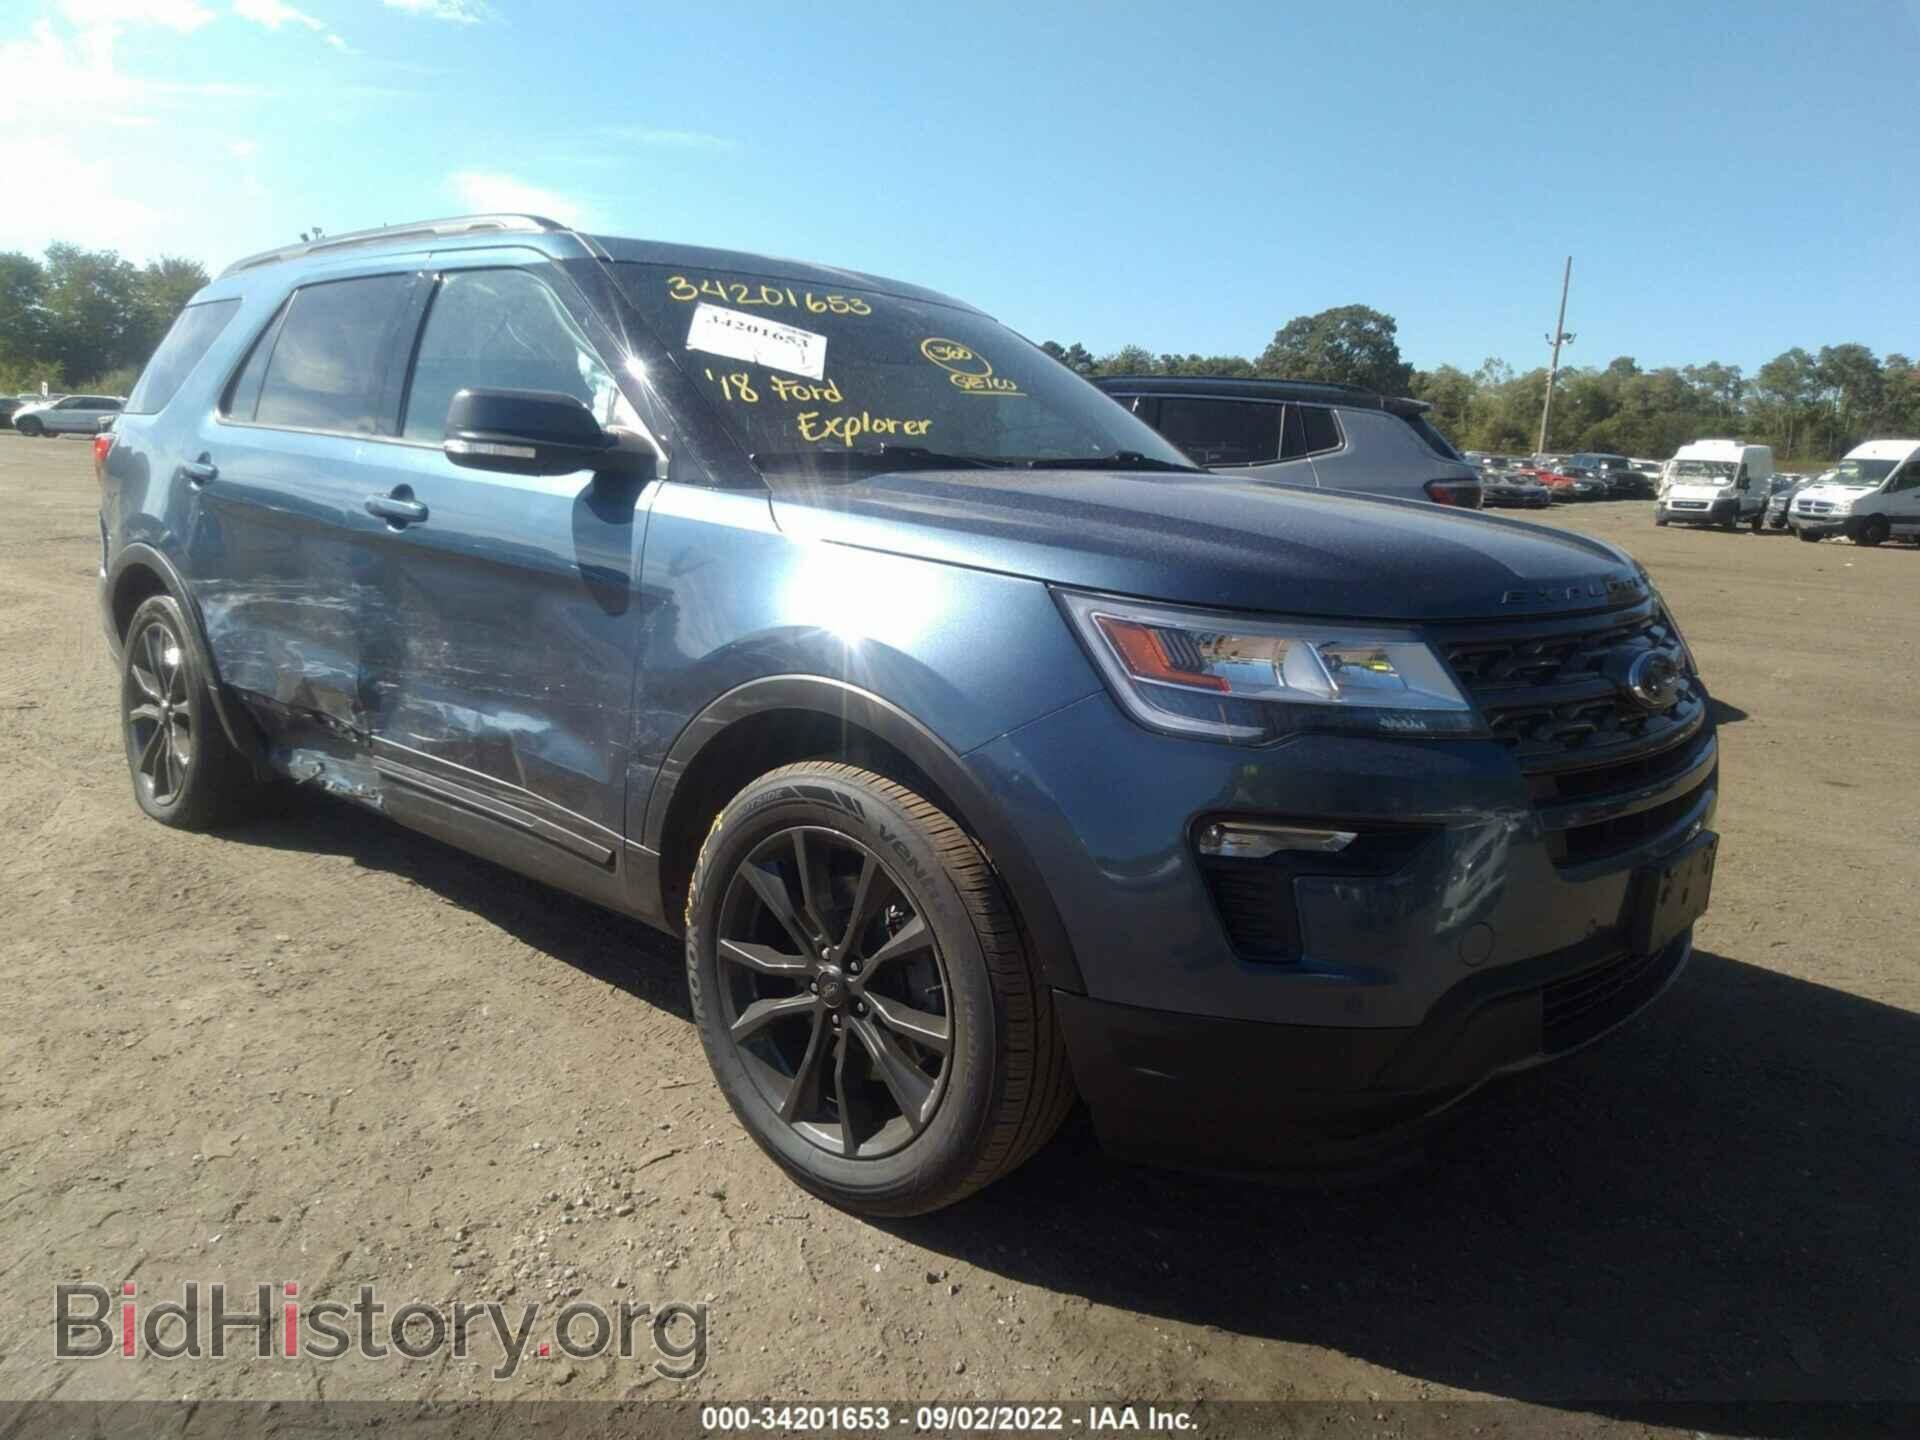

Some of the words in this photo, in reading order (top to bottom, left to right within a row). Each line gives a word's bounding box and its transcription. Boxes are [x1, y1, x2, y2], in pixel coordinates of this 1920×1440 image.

[668, 276, 872, 316] 34201653
[770, 378, 843, 403] Ford
[797, 411, 932, 448] Explorer
